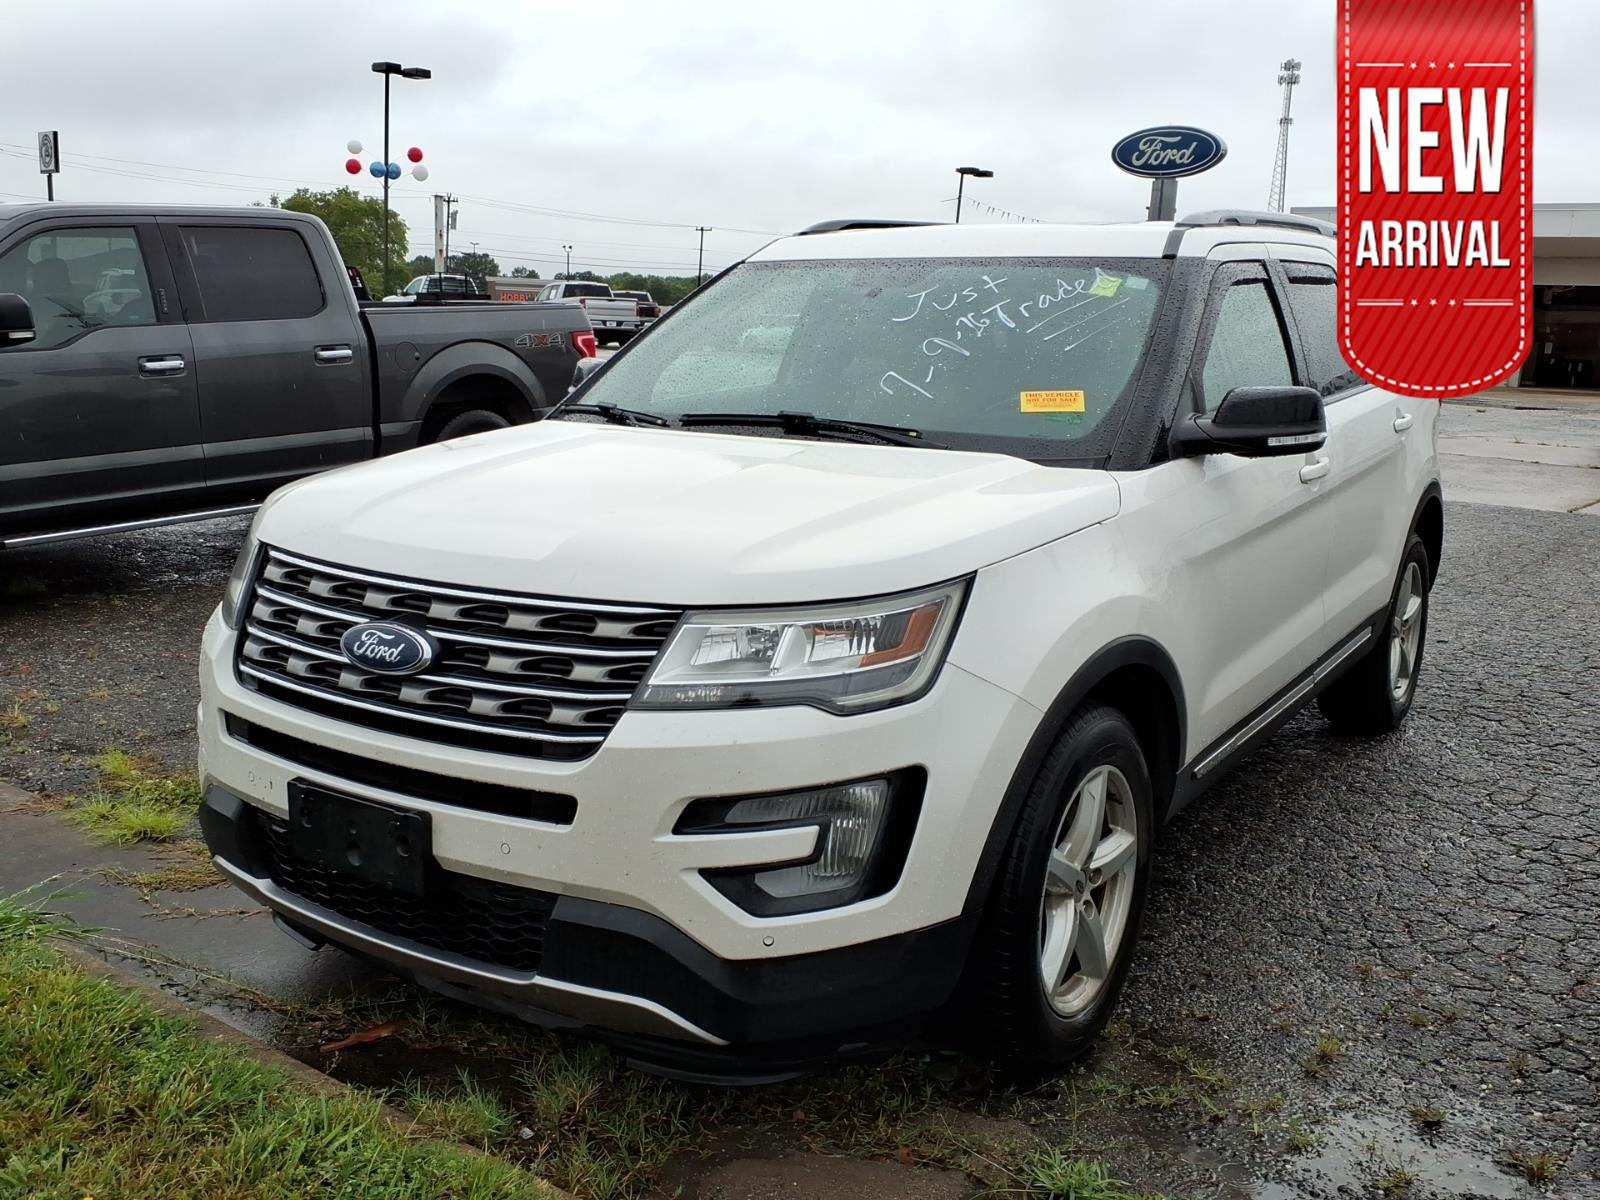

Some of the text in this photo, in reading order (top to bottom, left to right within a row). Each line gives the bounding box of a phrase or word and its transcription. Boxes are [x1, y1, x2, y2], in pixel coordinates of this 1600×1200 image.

[1131, 135, 1198, 167] Ford
[891, 275, 1009, 322] Just
[353, 629, 406, 663] Ford
